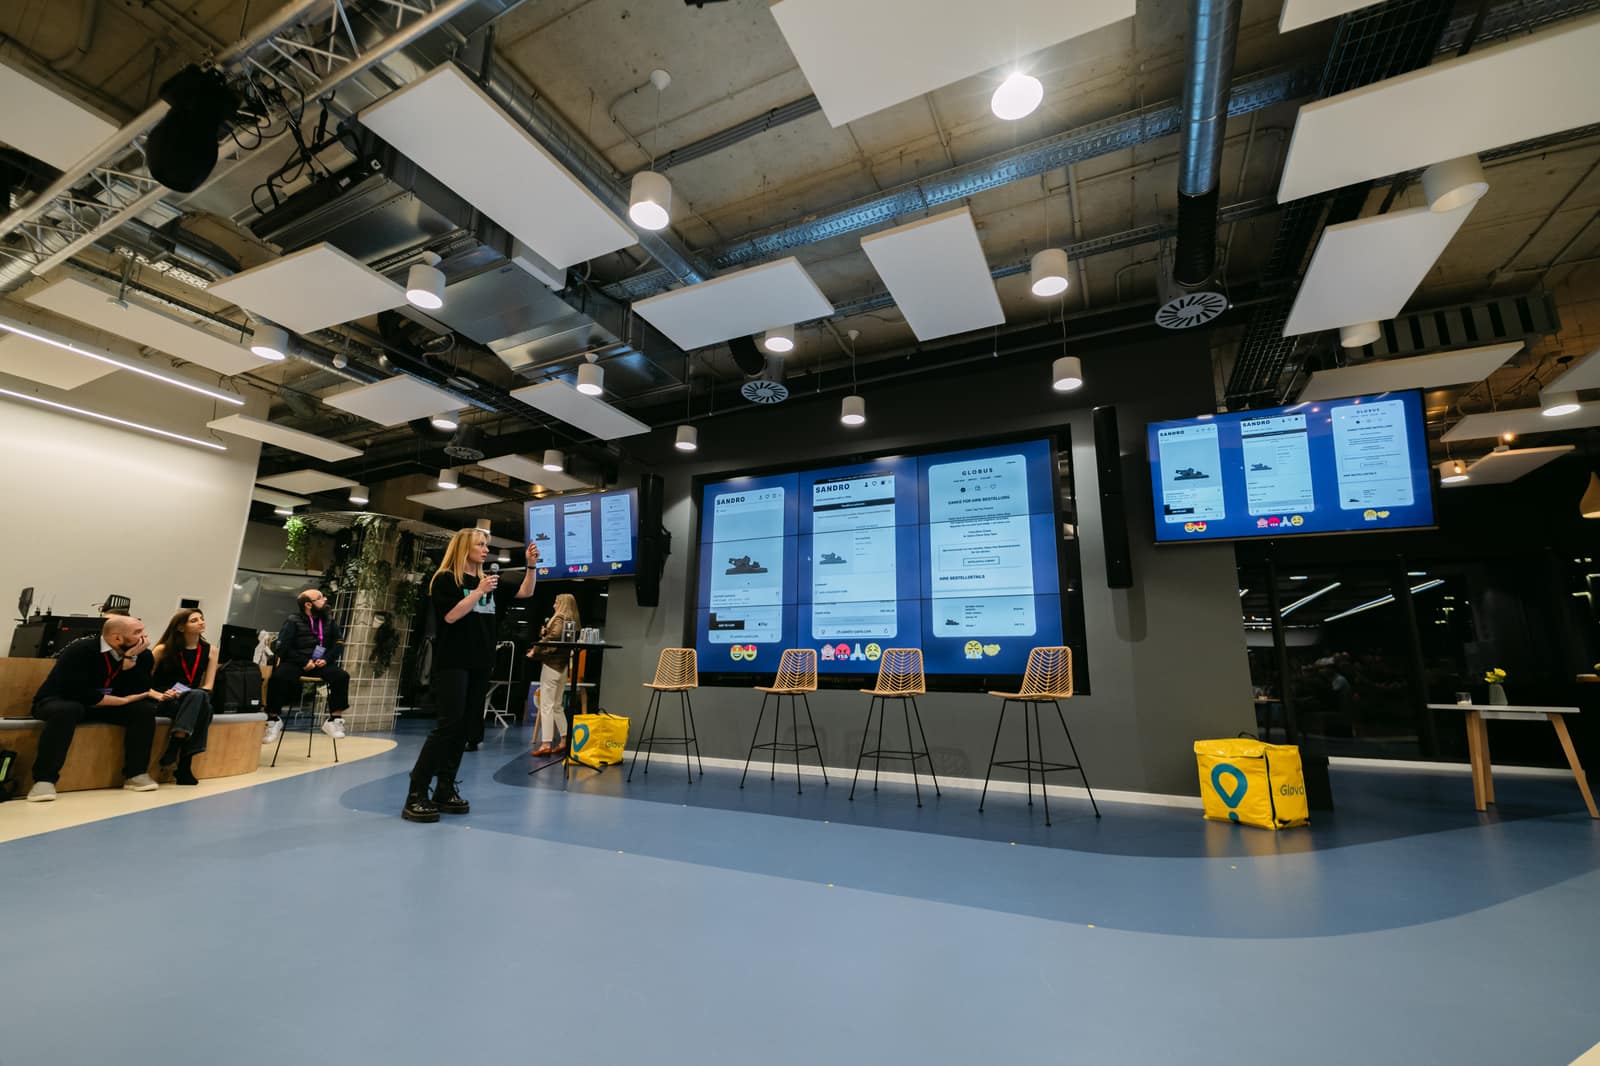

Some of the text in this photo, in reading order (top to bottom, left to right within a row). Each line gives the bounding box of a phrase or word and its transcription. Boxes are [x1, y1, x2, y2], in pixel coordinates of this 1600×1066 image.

[962, 467, 993, 476] GLOBUS
[815, 483, 850, 494] SANDRO
[716, 496, 746, 506] SANDRO
[1280, 783, 1305, 796] Glovo
